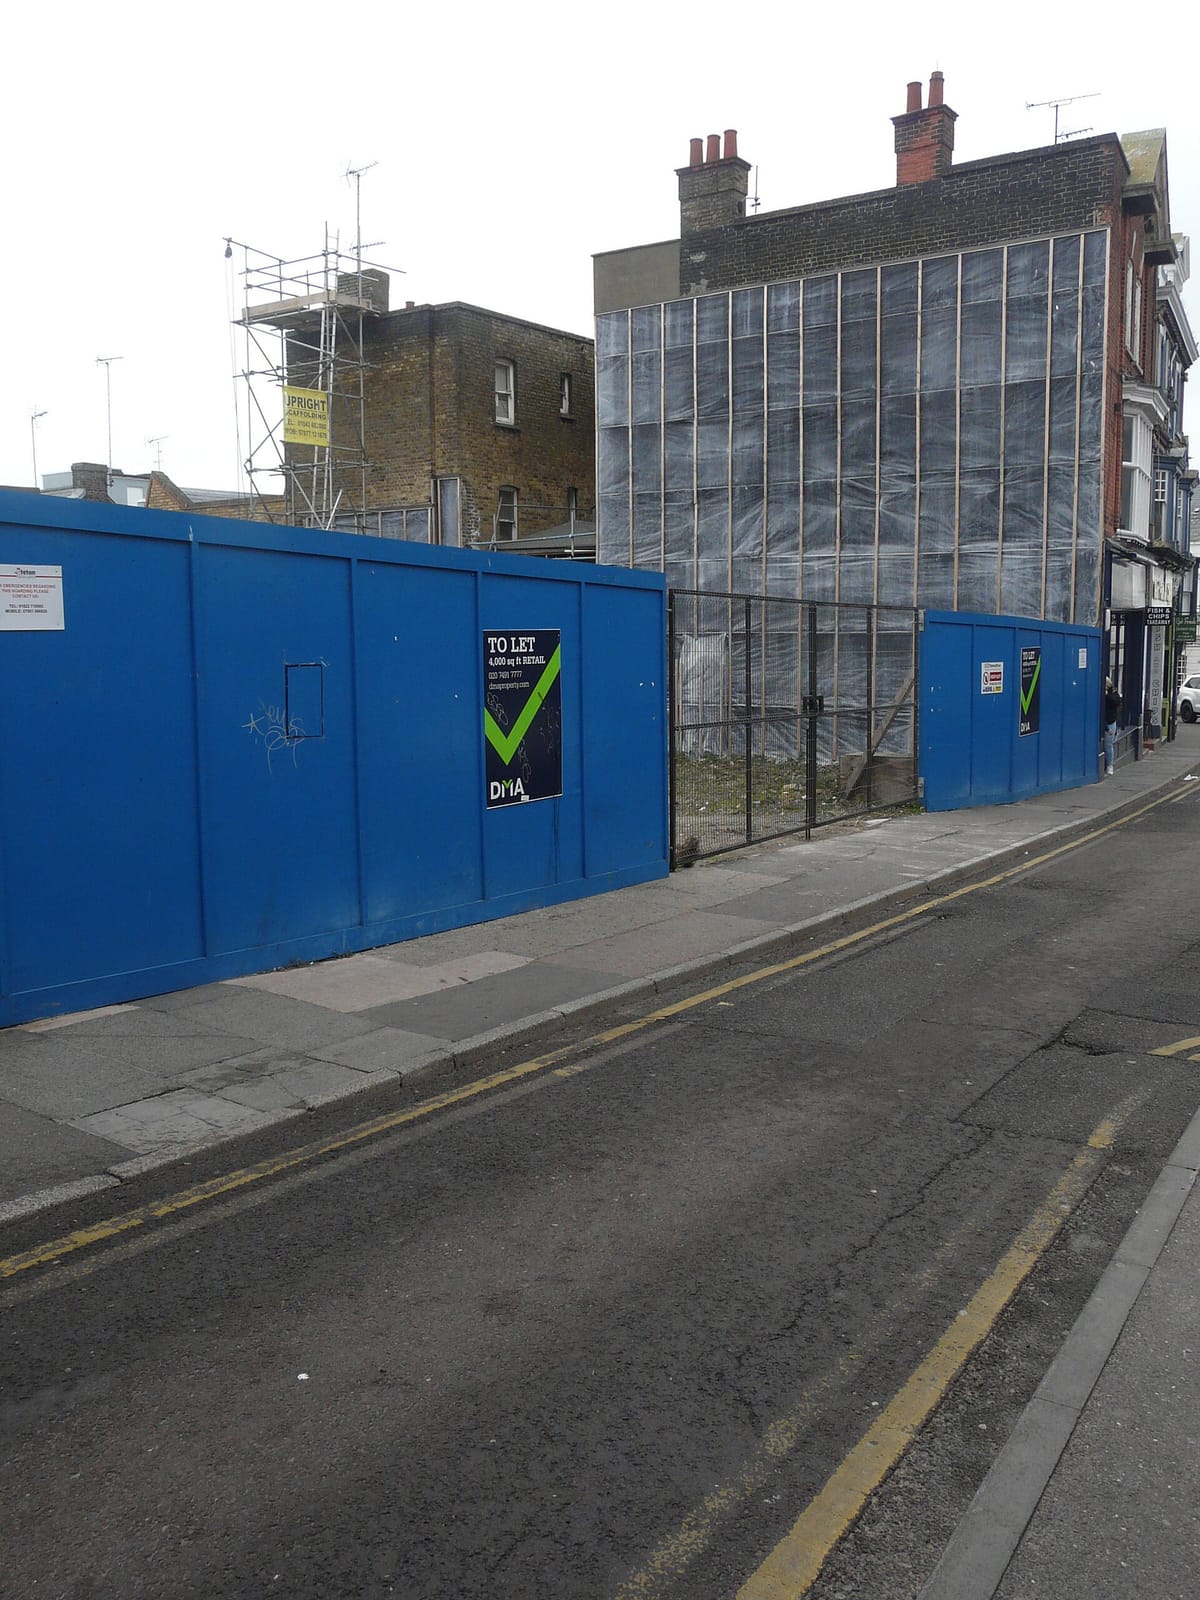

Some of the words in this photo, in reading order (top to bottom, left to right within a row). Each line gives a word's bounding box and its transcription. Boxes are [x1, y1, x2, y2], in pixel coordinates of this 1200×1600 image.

[286, 409, 326, 420] CAFFOLDING
[488, 637, 507, 653] TO
[510, 637, 536, 653] LET
[488, 656, 506, 667] 4,000
[507, 658, 515, 667] sq
[516, 656, 522, 665] ft
[522, 655, 546, 665] RETAIL
[490, 778, 525, 800] DMA
